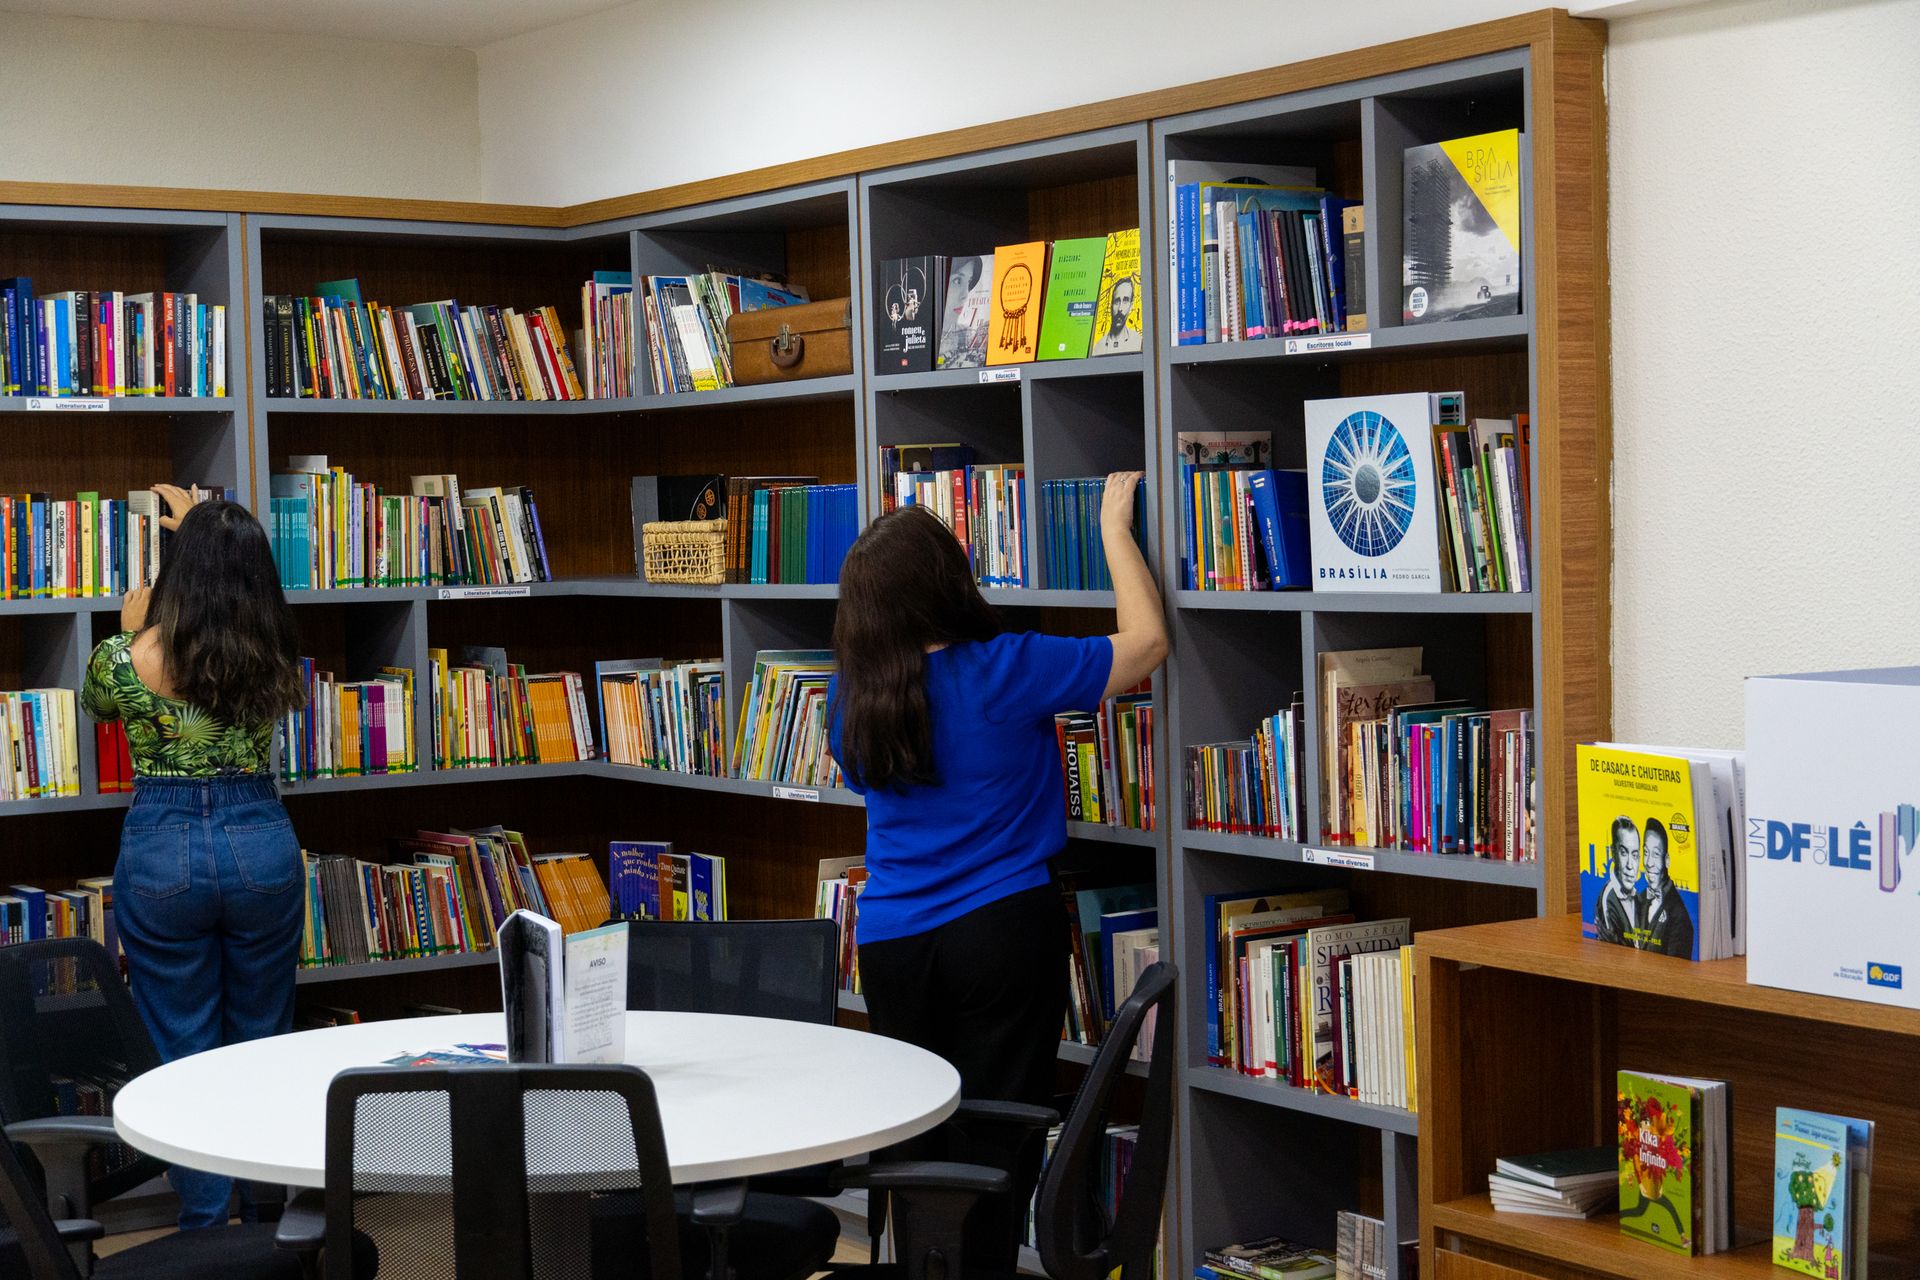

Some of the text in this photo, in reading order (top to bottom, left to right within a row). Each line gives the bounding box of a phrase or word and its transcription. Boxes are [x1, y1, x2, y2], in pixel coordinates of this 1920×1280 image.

[902, 326, 922, 336] romeu
[903, 335, 926, 353] julieta
[1307, 341, 1334, 350] Escritores
[403, 335, 416, 373] PRINCESA
[995, 372, 1016, 381] Educação
[88, 403, 104, 411] geral
[1319, 565, 1388, 579] BRASÍLIA
[491, 589, 526, 597] infantojuvenil
[1590, 759, 1681, 784] DE CASACA E CHUTEIRAS
[1066, 741, 1081, 816] HOUAISS
[1613, 779, 1659, 793] SILVESTRE GORGULHO
[788, 791, 805, 799] Literatura
[1671, 823, 1687, 832] BRASIL
[1748, 818, 1871, 871] UM DF QUE LÊ
[621, 847, 645, 859] mulher
[623, 859, 635, 868] que
[1326, 856, 1369, 869] Temas diversos
[623, 867, 646, 878] minha
[1316, 925, 1404, 943] COMO SERIA
[589, 957, 607, 968] AVISO
[1840, 966, 1863, 976] Secretaria
[1840, 972, 1863, 982] Educação
[1883, 973, 1900, 983] GDF
[1639, 1129, 1658, 1147] Kika
[1639, 1148, 1667, 1169] Infinito
